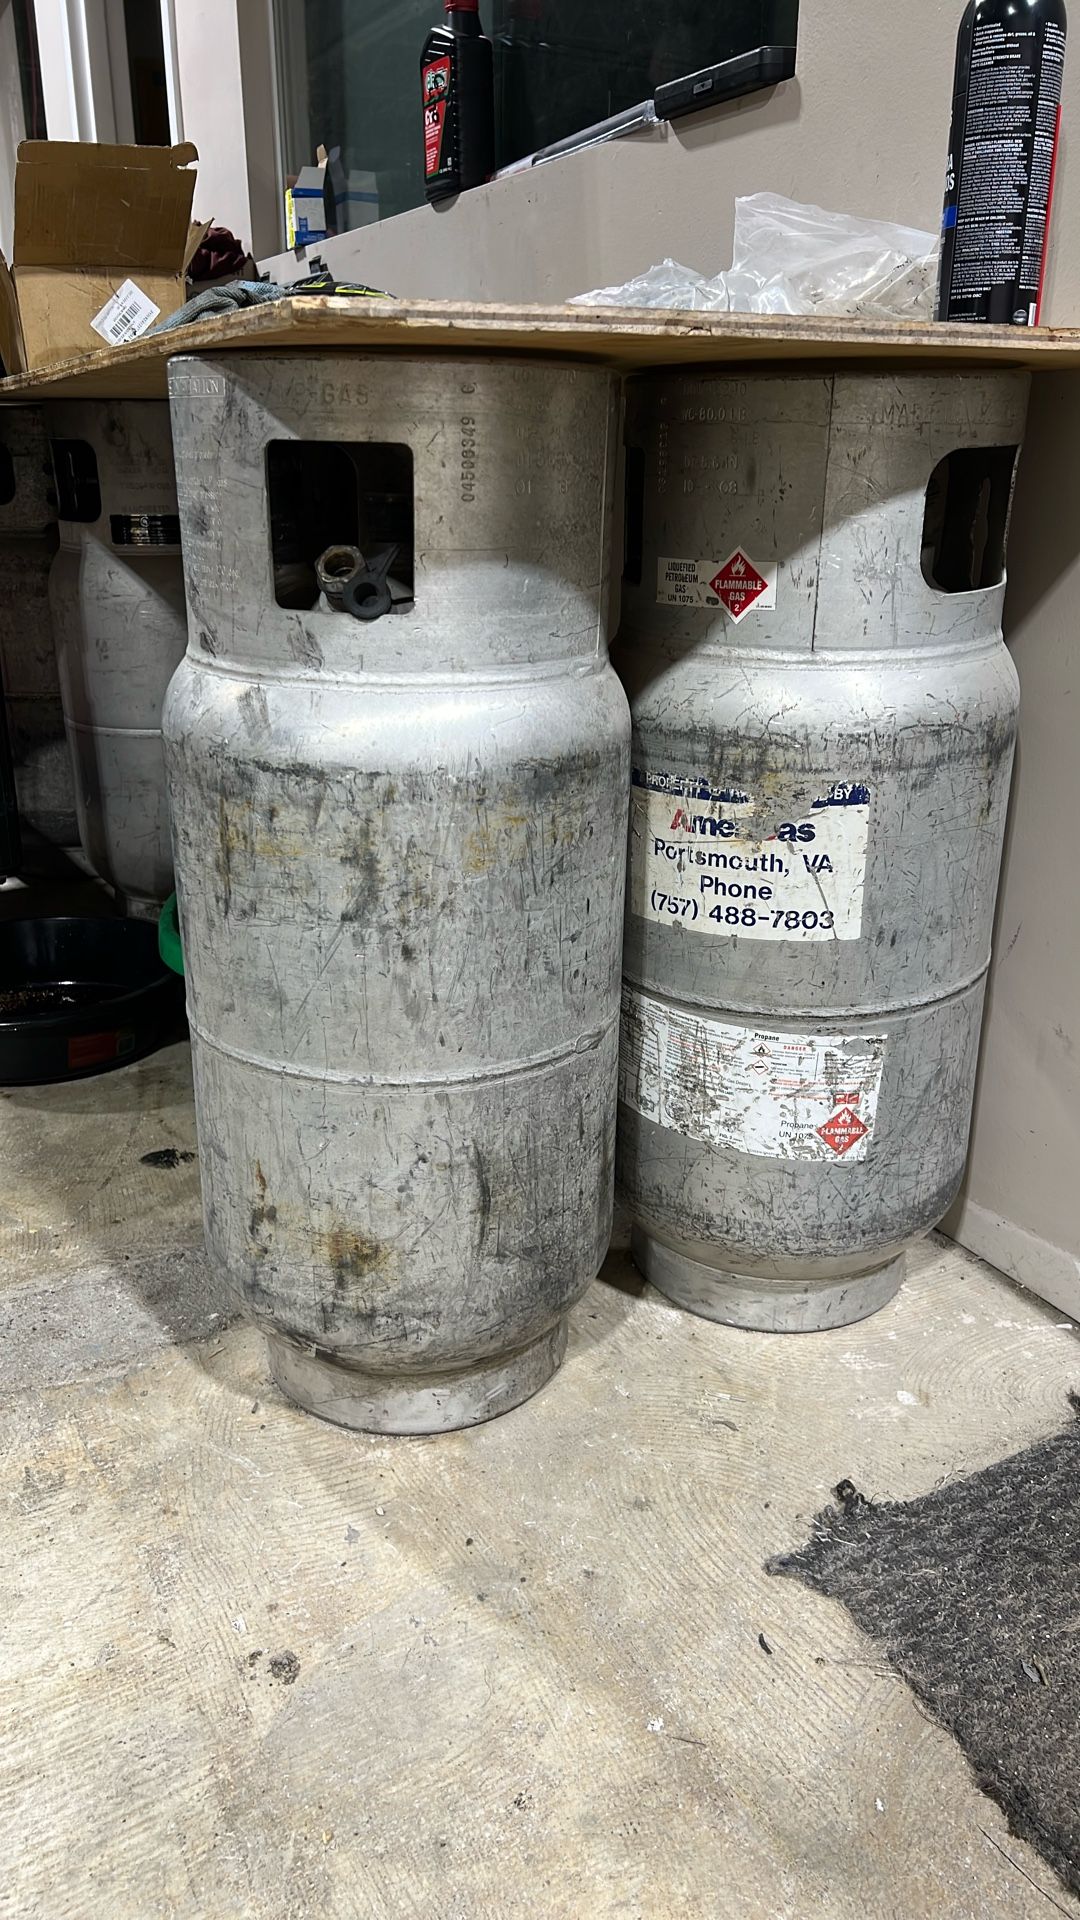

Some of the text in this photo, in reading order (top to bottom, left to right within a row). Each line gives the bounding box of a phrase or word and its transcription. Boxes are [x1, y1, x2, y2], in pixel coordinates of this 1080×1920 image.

[668, 562, 696, 572] LIQUEFIED
[665, 572, 698, 583] PETROLEUM
[674, 584, 686, 593] GAS
[715, 580, 762, 590] FLAMMABLE
[679, 595, 694, 603] 1075
[729, 592, 746, 601] GAS
[734, 604, 740, 612] 2
[834, 788, 853, 800] BY
[670, 808, 816, 843] Ameas
[654, 838, 834, 878] Portsmouth, VA
[700, 874, 774, 900] Phone
[651, 889, 834, 930] (757) 488-7803
[754, 1032, 780, 1042] Propane
[780, 1120, 814, 1130] Propane
[794, 1132, 813, 1140] 1075
[820, 1127, 864, 1135] FLAMMABLE
